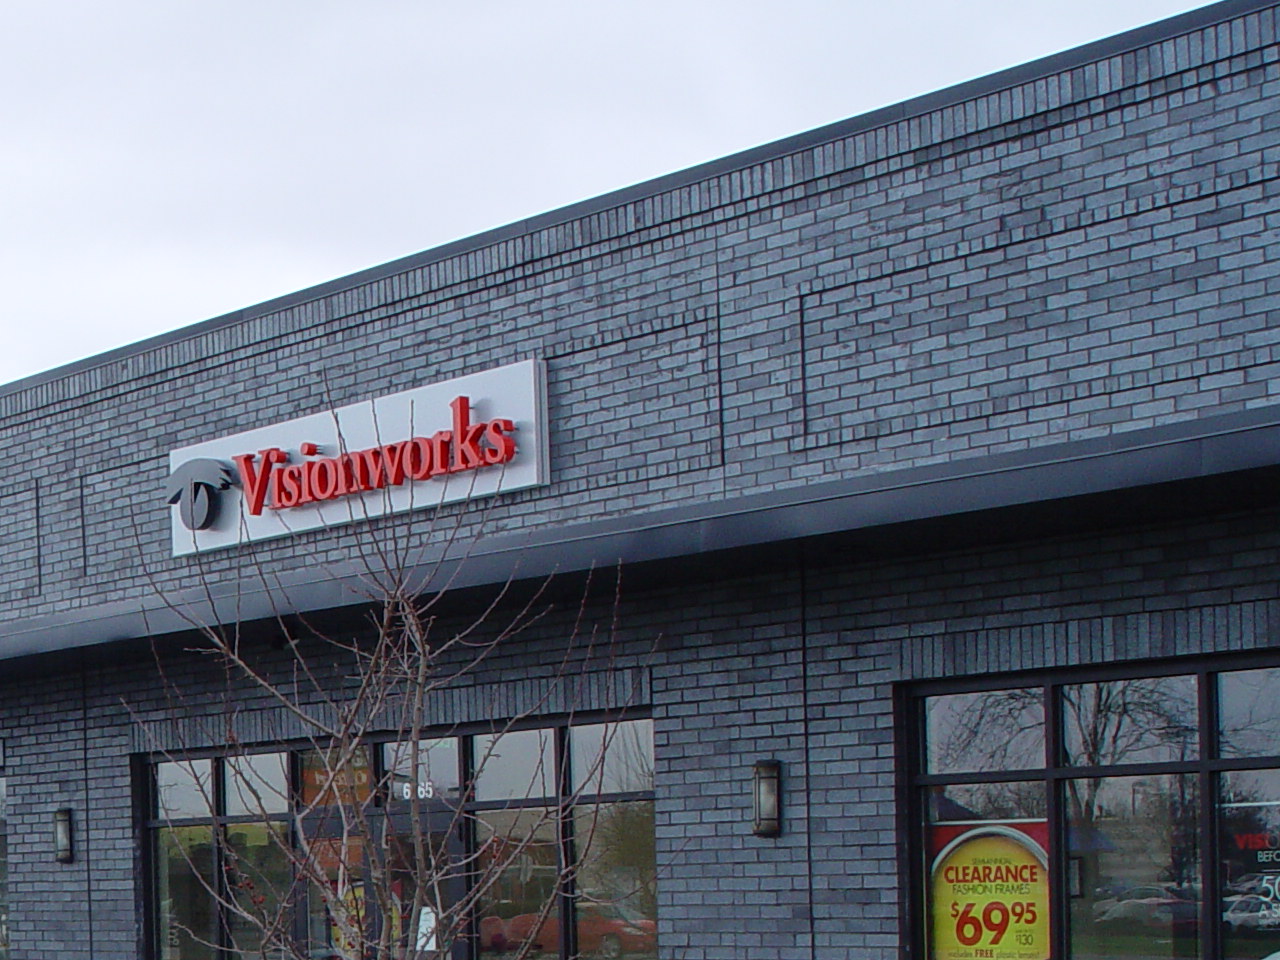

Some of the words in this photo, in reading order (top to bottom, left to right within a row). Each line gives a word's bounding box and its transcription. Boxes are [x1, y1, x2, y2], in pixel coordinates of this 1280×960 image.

[231, 395, 518, 516] Visionworks
[402, 782, 433, 799] 665
[943, 864, 1038, 884] CLEARANCE
[952, 884, 992, 895] FASHION
[994, 883, 1031, 895] FRAMES
[975, 948, 994, 958] FREE
